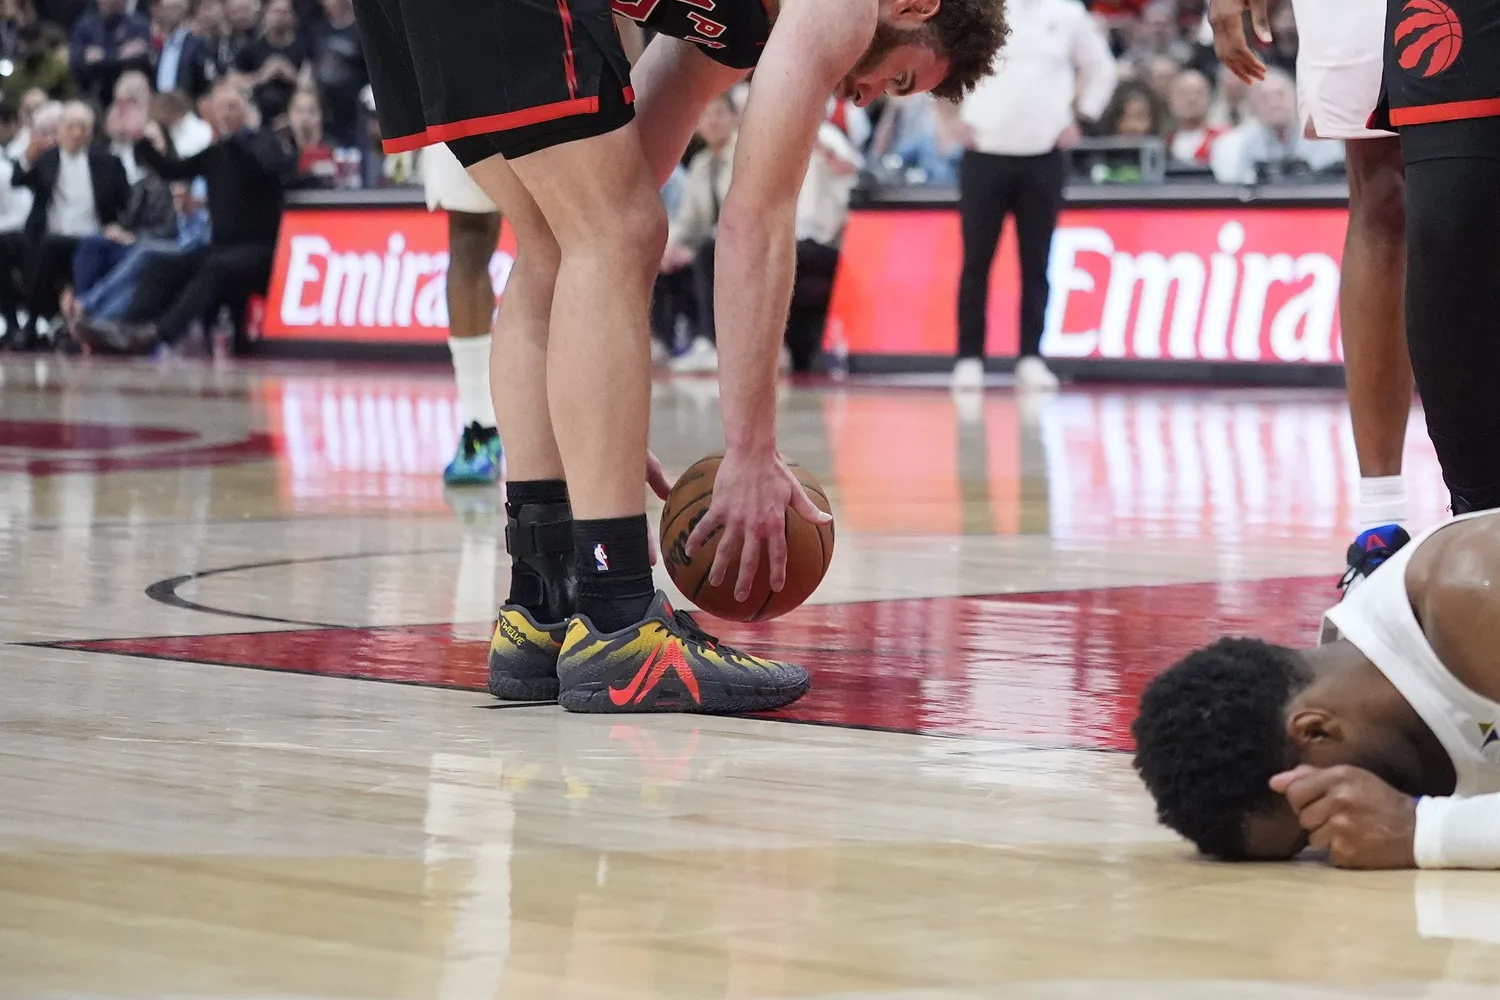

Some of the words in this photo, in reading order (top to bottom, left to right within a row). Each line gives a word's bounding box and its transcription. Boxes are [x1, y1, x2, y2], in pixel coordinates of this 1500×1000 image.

[281, 232, 514, 328] Emira
[1039, 220, 1345, 363] Emira
[501, 616, 526, 646] TWELVE
